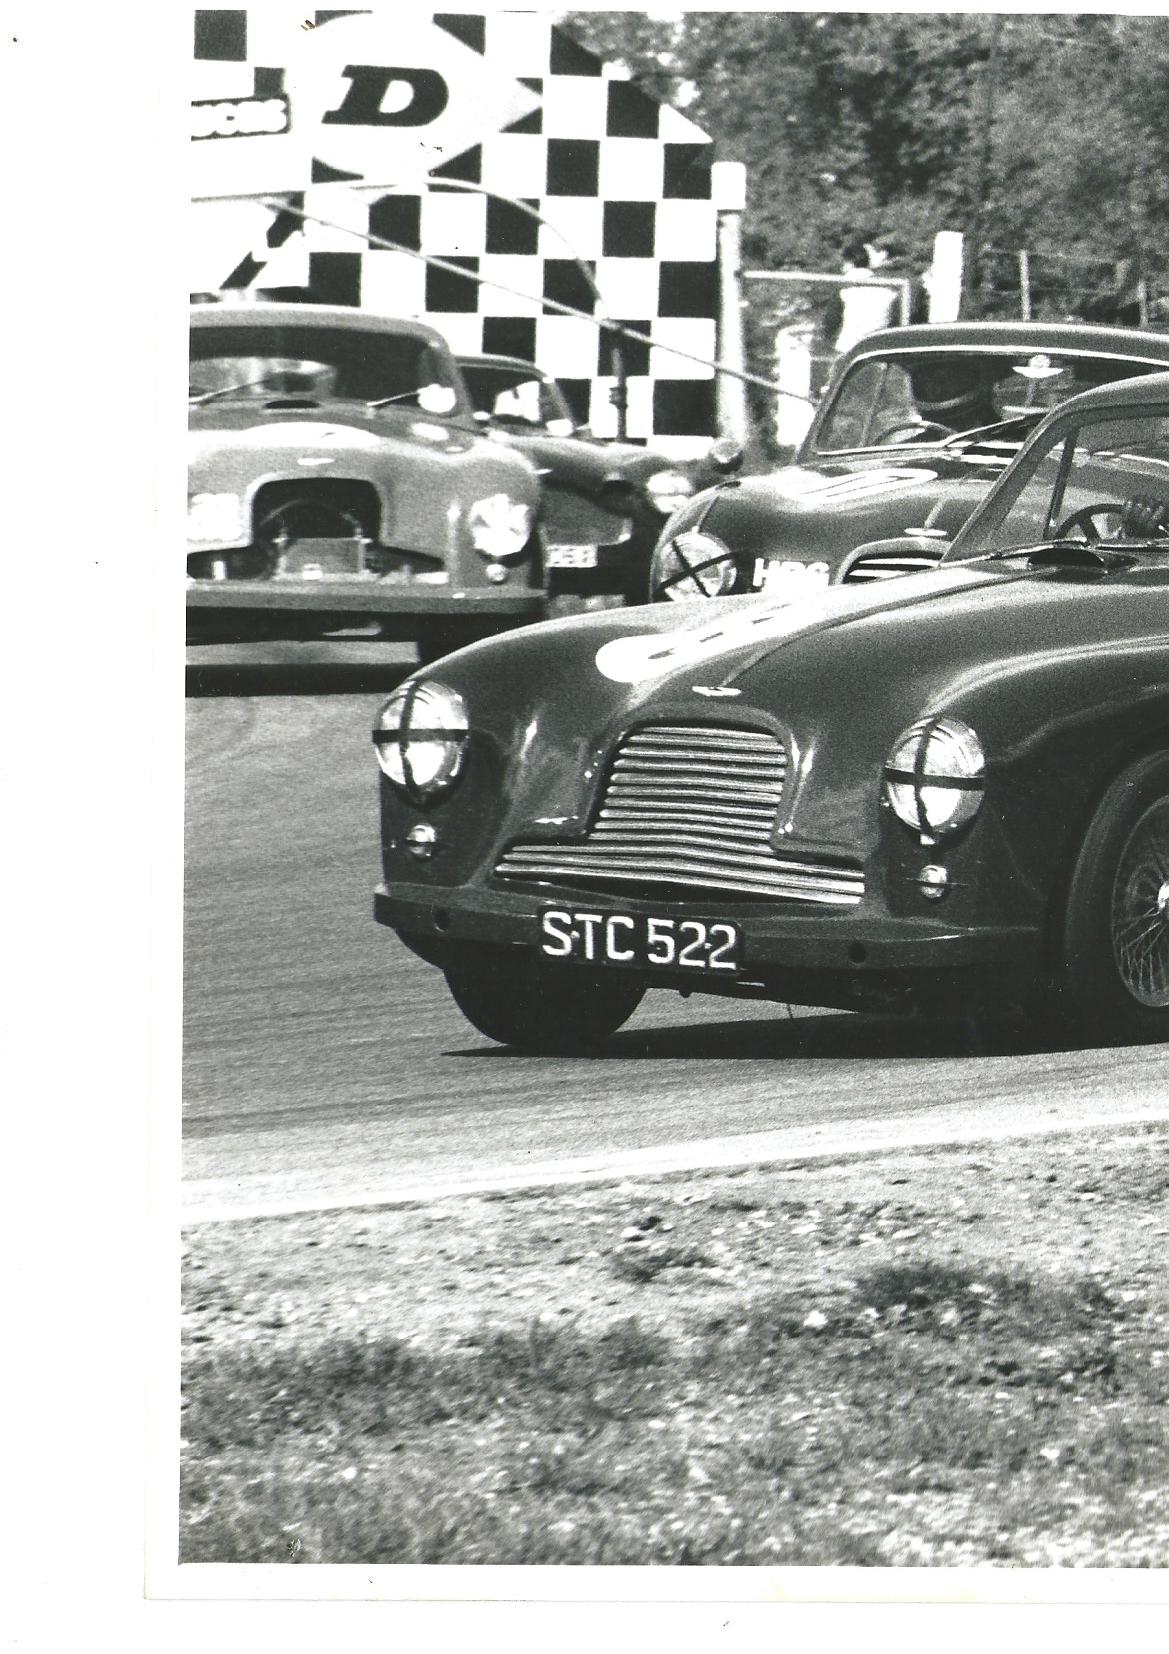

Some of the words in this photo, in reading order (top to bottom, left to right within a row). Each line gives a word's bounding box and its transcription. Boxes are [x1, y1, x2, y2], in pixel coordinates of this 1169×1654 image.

[321, 65, 449, 128] D
[542, 911, 635, 960] STC
[647, 918, 737, 970] 522
